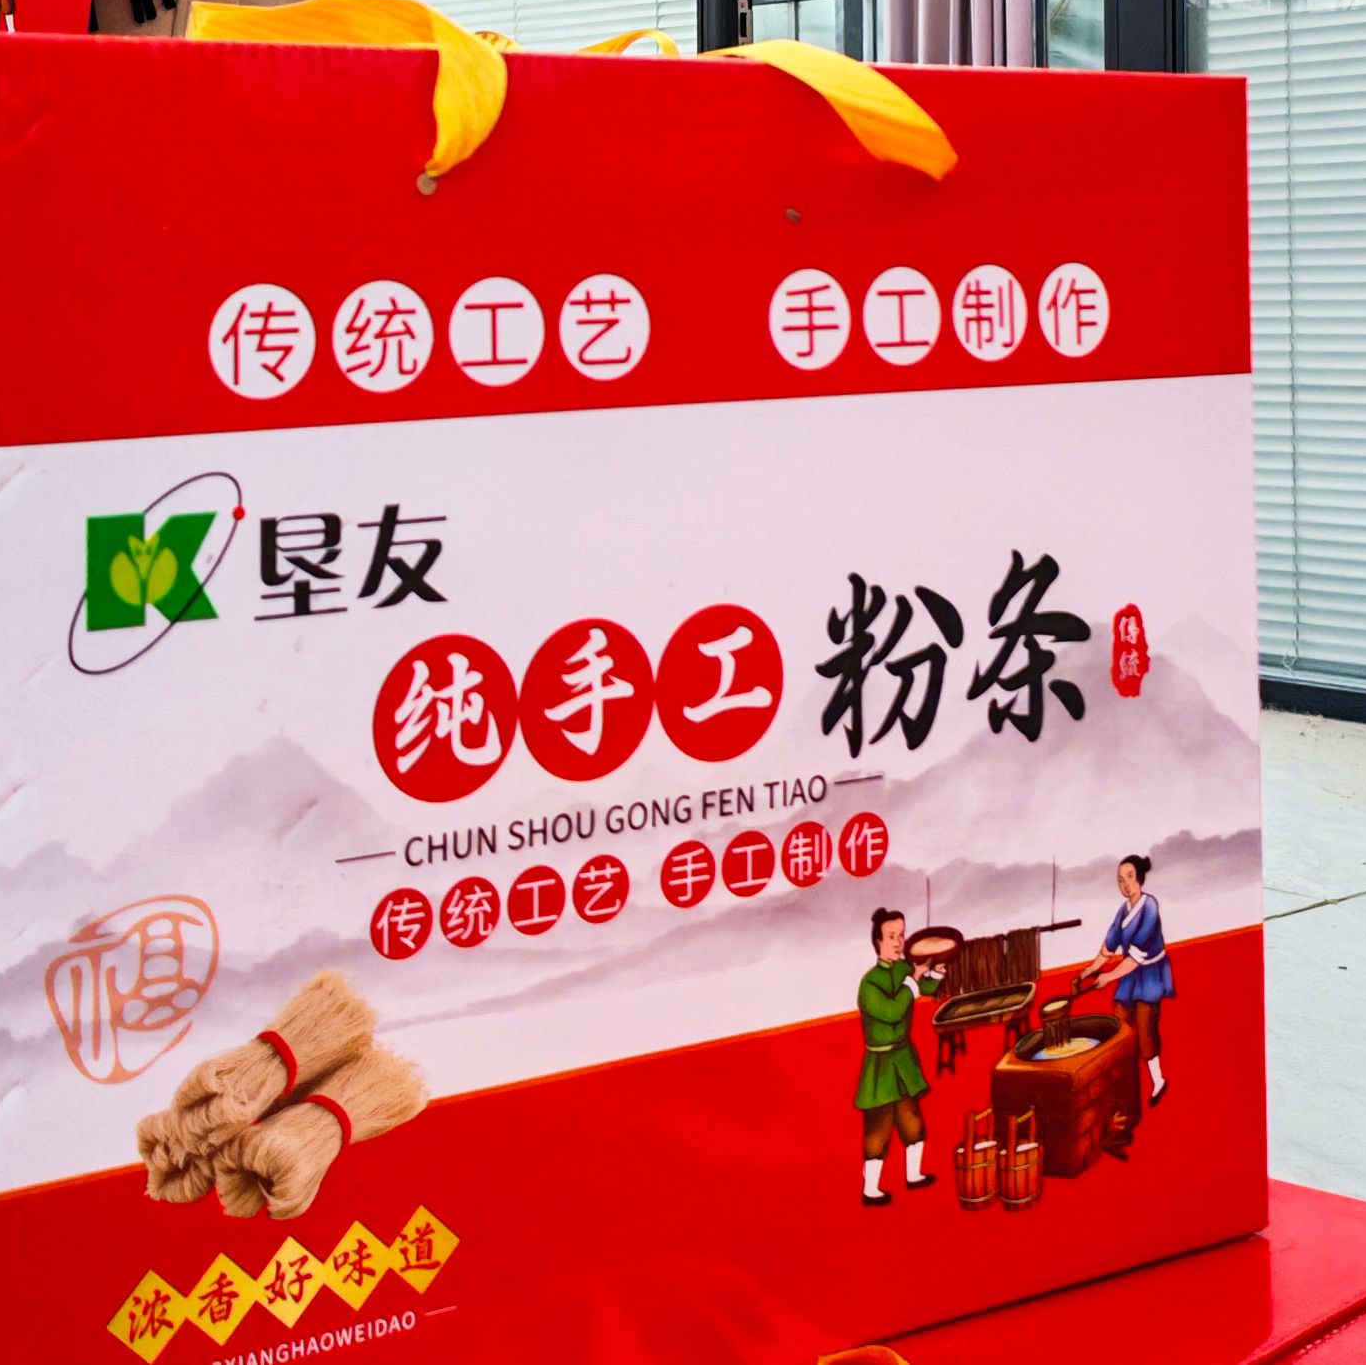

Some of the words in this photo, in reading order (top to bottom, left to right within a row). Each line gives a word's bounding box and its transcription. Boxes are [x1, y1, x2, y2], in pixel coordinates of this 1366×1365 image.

[222, 283, 633, 387] 传统工艺
[781, 274, 1102, 357] 手工制作
[253, 503, 450, 623] 垦友
[393, 548, 1093, 775] 纯手工粉条
[404, 828, 502, 868] CHUN
[507, 811, 597, 849] SHOU
[604, 796, 693, 832] GONG
[701, 784, 755, 819] FEN
[762, 773, 828, 806] TIAO
[377, 861, 625, 956] 传统工艺
[667, 818, 885, 903] 手工制作
[128, 1222, 442, 1345] 浓香好味道
